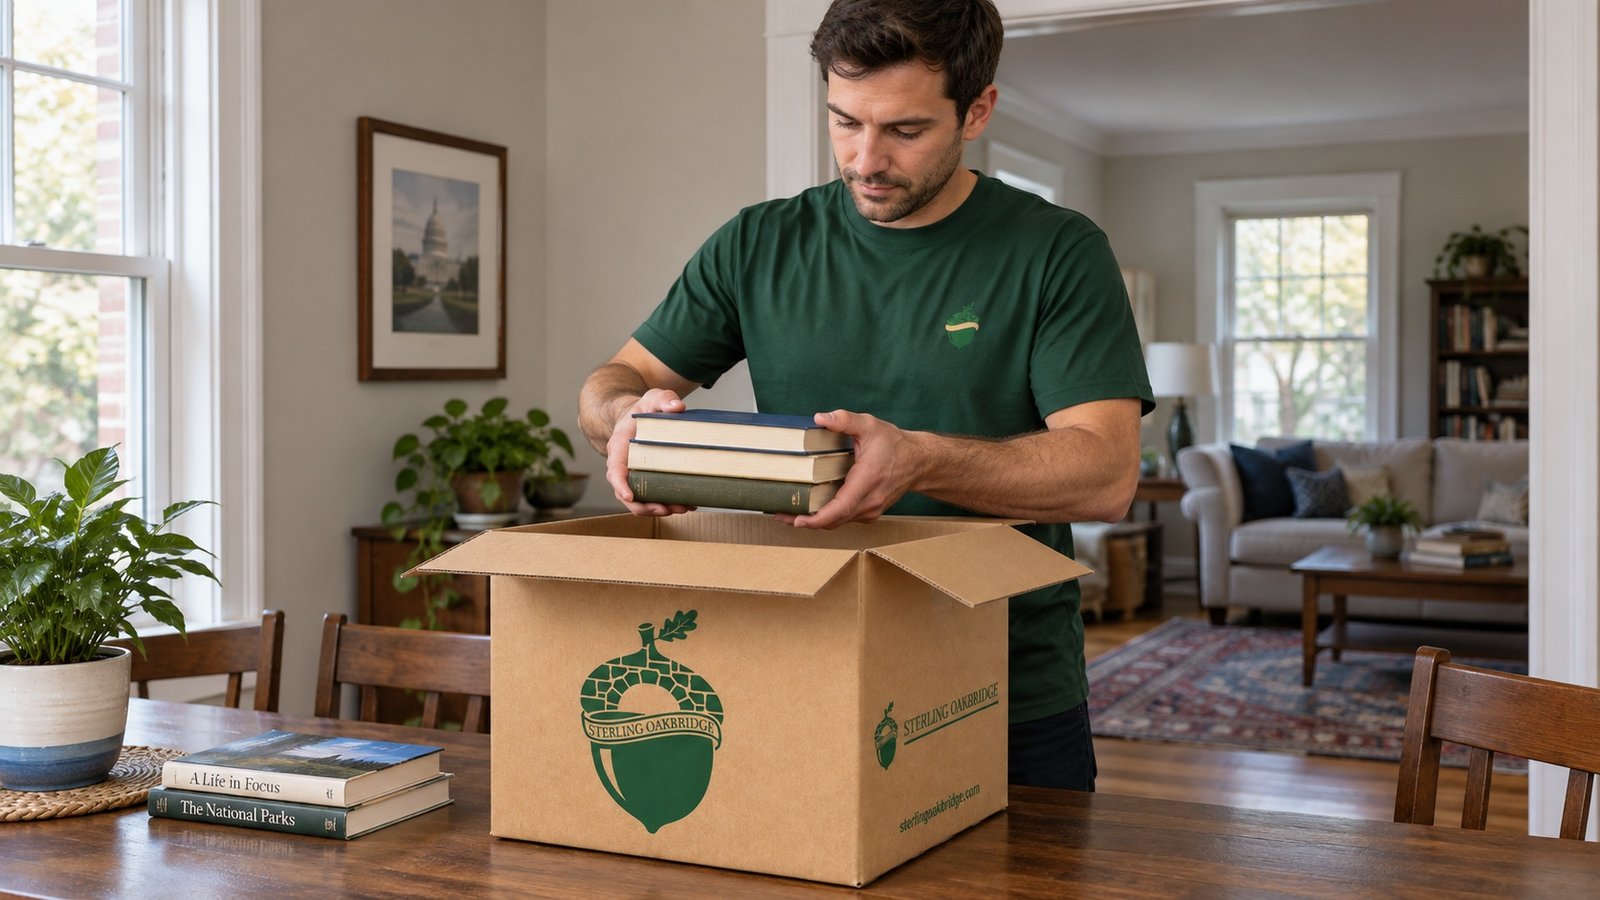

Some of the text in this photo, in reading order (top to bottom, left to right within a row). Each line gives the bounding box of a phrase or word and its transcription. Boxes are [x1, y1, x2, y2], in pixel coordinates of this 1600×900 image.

[903, 682, 999, 737] STERLING OAKBRIDGE
[588, 717, 715, 739] STERLING OAKBRIDGE
[189, 772, 281, 793] A Life in Focus
[180, 799, 204, 816] The
[206, 802, 258, 822] National
[261, 808, 296, 826] Parks
[899, 783, 981, 833] sterlingoakbridge.com
